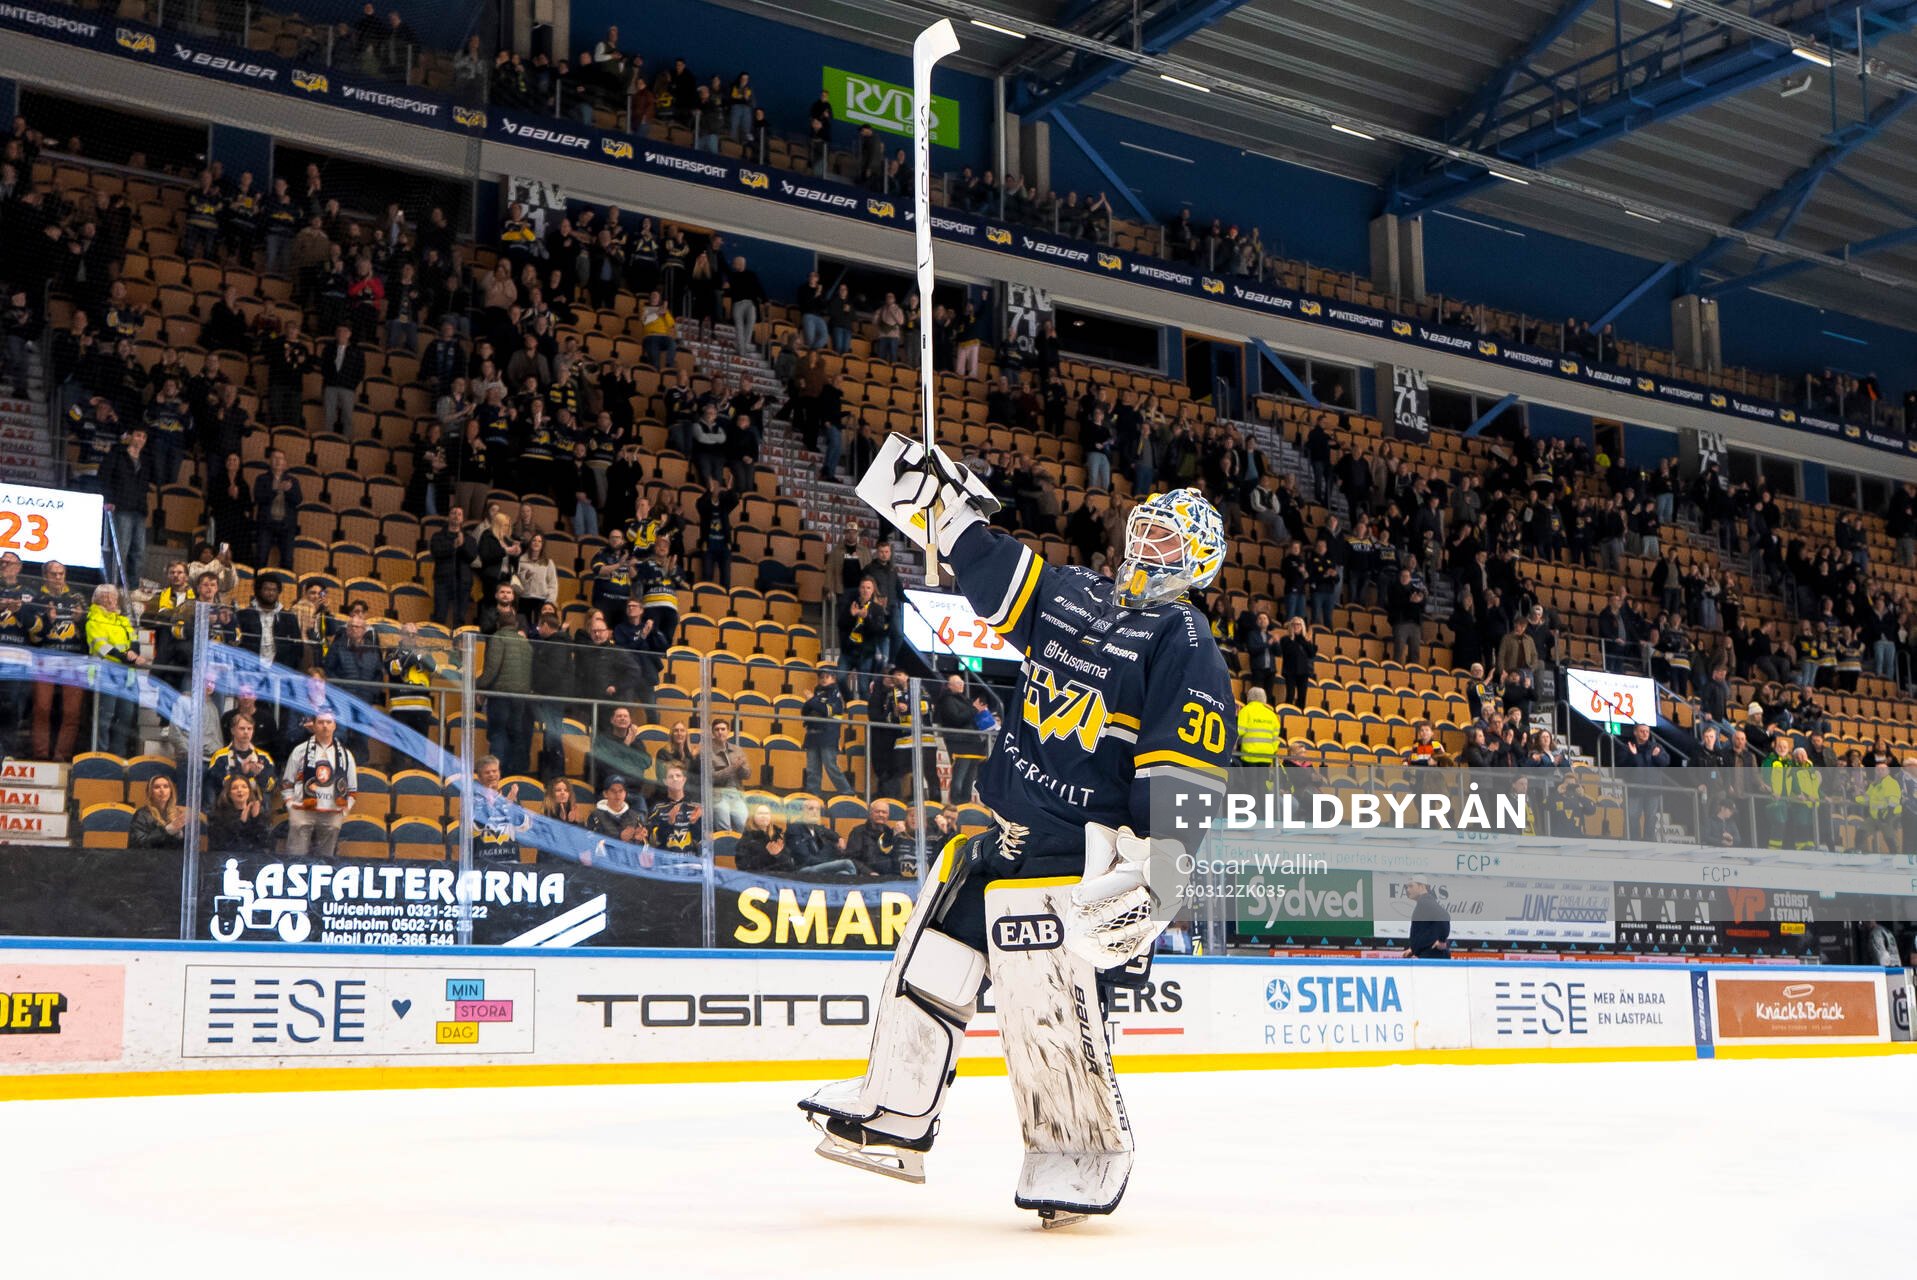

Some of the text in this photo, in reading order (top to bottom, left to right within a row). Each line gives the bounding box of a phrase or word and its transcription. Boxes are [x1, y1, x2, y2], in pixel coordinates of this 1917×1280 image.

[0, 4, 99, 38] INTERSPORT
[191, 53, 277, 81] BAUER
[355, 88, 438, 116] INTERSPORT
[518, 126, 590, 149] BAUER
[656, 155, 728, 178] INTERSPORT
[795, 187, 858, 209] BAUER
[930, 216, 977, 236] ERSPORT
[1035, 243, 1088, 262] BAUER
[1139, 267, 1194, 286] INTERSPORT
[1244, 291, 1292, 309] BAUER
[1336, 311, 1384, 328] INTERSPORT
[1430, 333, 1472, 350] BAUER
[1510, 351, 1553, 368] INTERSPORT
[1395, 387, 1417, 415] 71
[17, 496, 64, 509] DAGAR
[937, 616, 1005, 650] 6-23
[1044, 614, 1078, 635] INTERSPORT
[1055, 646, 1109, 680] Husqvarna
[1590, 690, 1635, 717] 6-23
[1177, 702, 1226, 754] 30
[3, 765, 35, 778] AXI
[255, 863, 565, 906] ASFALTERARNA
[322, 902, 404, 916] Ulricehamn
[1248, 875, 1364, 929] Sydved
[1505, 894, 1558, 922] JUNE
[1728, 887, 1766, 924] YP
[1773, 891, 1809, 908] STÖRST
[322, 917, 389, 931] Tidaholm
[392, 919, 454, 932] 0502-716
[1776, 908, 1800, 922] STAN
[1802, 906, 1814, 922] PÅ
[321, 931, 454, 946] Mobil 0708-366 544
[999, 920, 1059, 946] EAB
[1297, 976, 1403, 1013] STENA
[208, 978, 479, 1044] HSE MIN
[461, 1005, 507, 1018] STORA
[577, 994, 870, 1027] TOSITO
[1495, 982, 1665, 1034] HSE MER ÄN BARA
[1598, 1012, 1664, 1025] EN LASTPALL
[1697, 992, 1707, 1041] BAUER
[1756, 1002, 1845, 1020] Knäck&Bräck
[443, 1026, 475, 1039] DAG
[1073, 984, 1099, 1076] BAUER
[1265, 1023, 1404, 1045] RECYCLING
